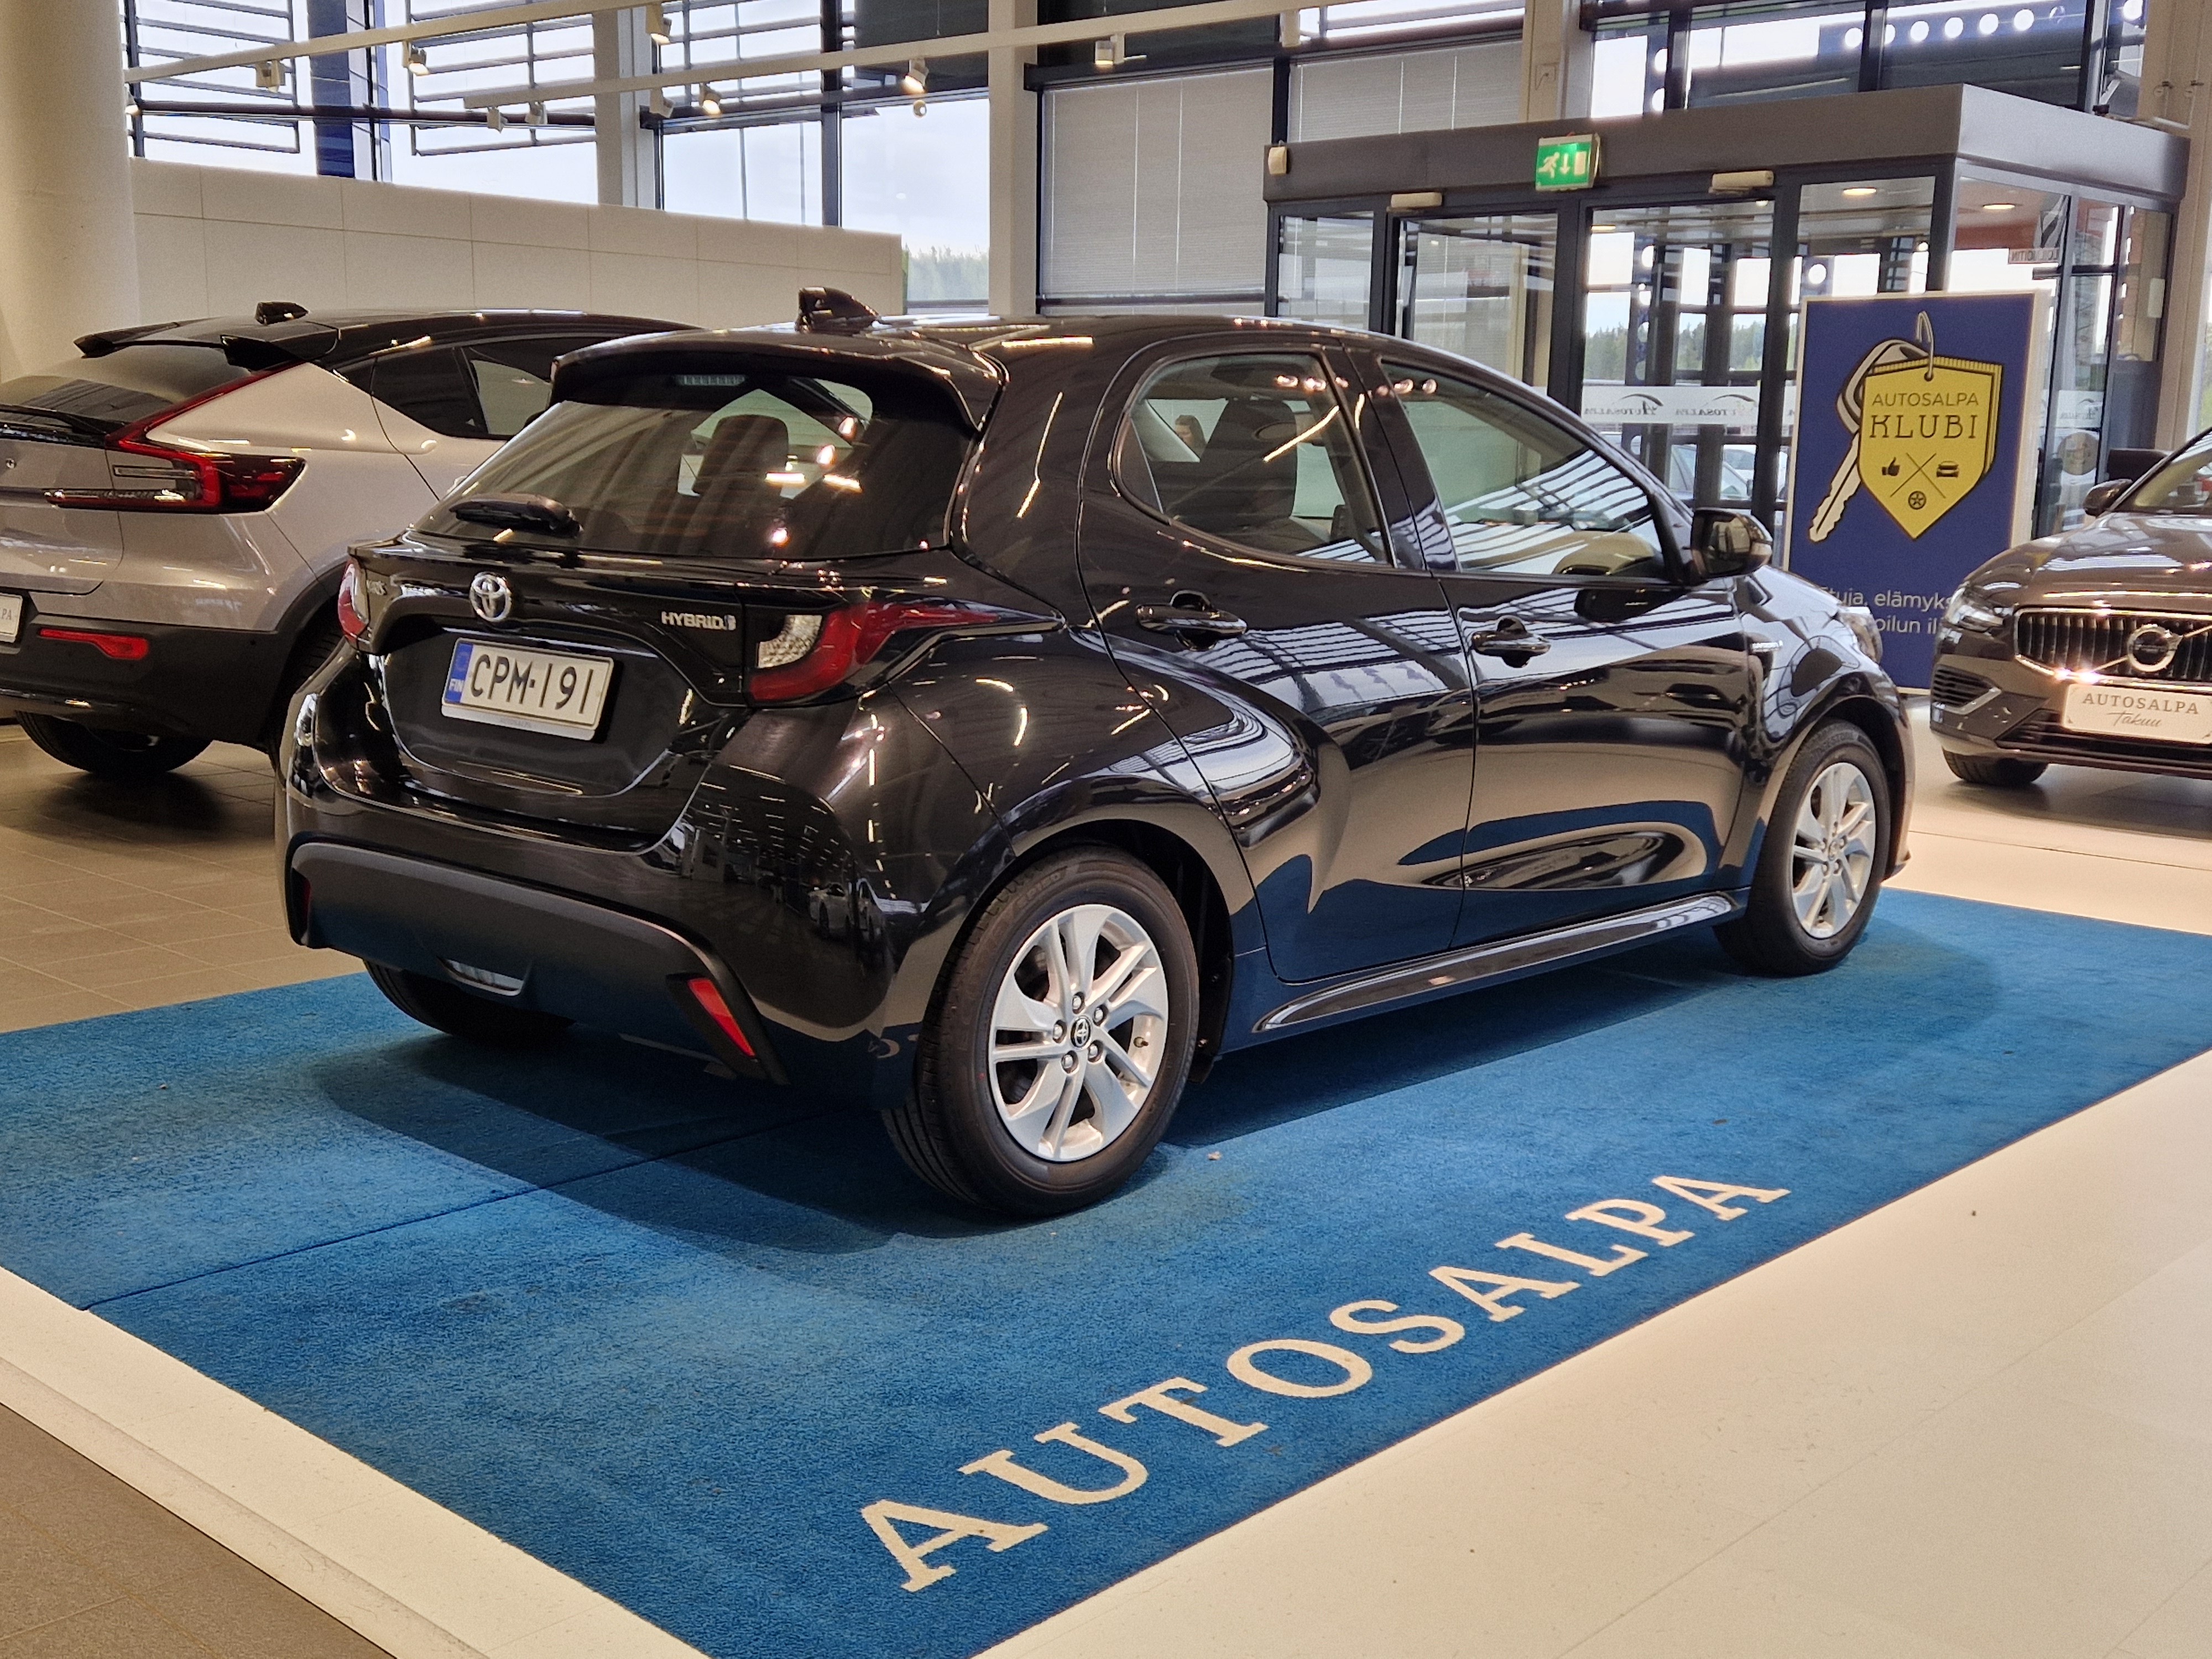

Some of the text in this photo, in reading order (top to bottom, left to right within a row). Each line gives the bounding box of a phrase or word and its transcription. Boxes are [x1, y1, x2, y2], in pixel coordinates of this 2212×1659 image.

[1872, 393, 1979, 406] AUTOSALPA
[1870, 415, 1978, 439] KLUBI
[661, 611, 723, 630] HYBRID
[449, 679, 465, 692] FIN
[470, 654, 594, 714] CPM-191
[2083, 693, 2199, 714] AUTOSALPA
[2106, 711, 2162, 727] Takuu
[860, 1173, 1792, 1593] AUTOSALPA
